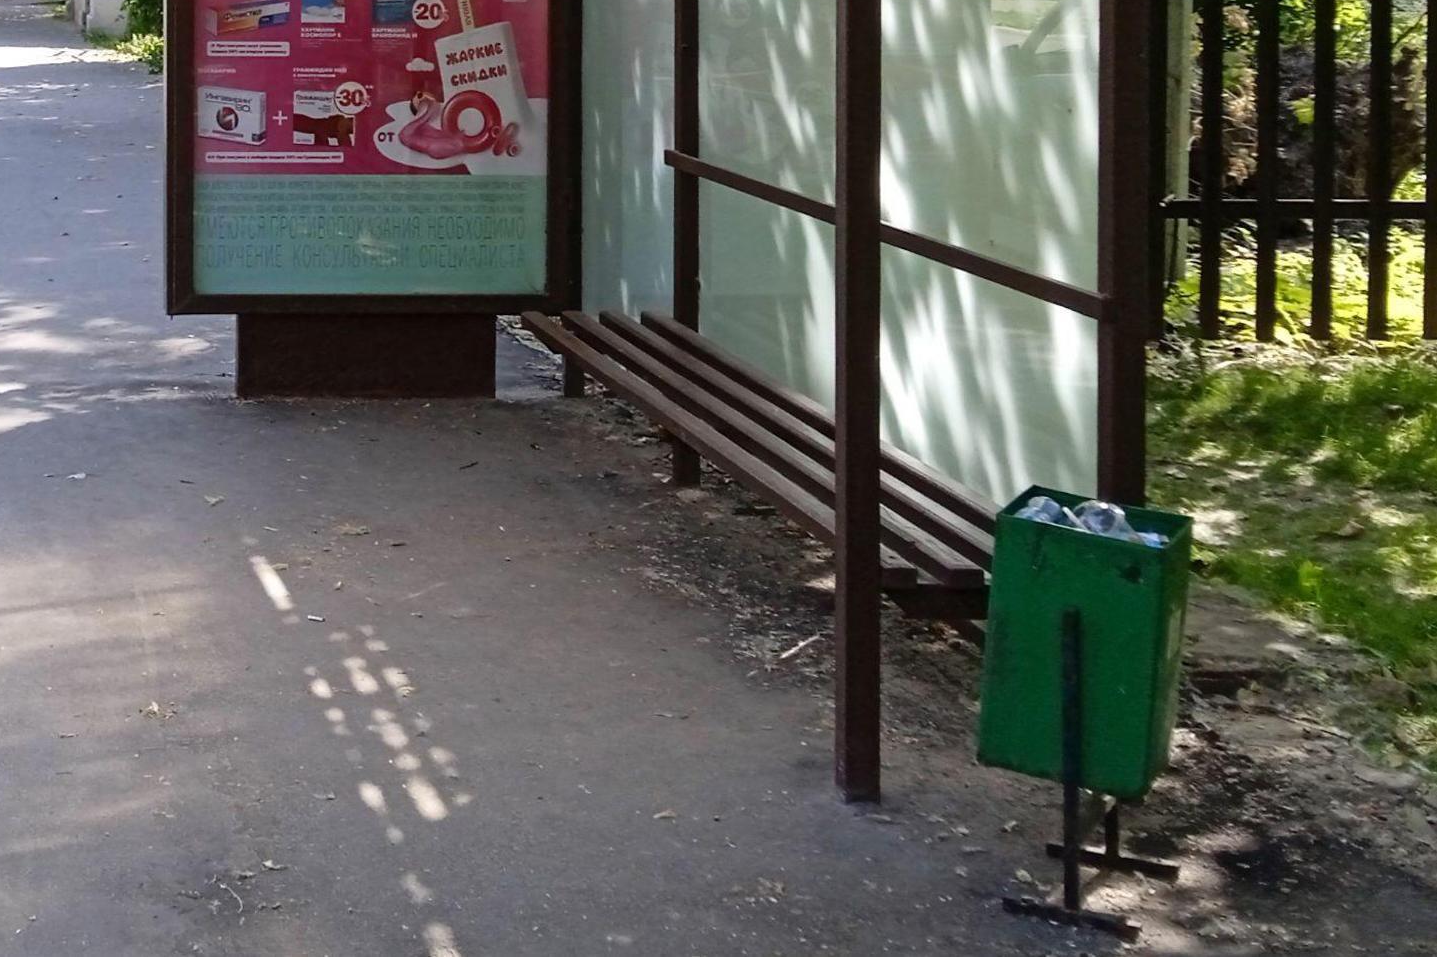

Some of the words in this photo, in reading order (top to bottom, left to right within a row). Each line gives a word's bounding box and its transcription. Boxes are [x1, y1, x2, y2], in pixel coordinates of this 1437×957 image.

[445, 42, 504, 66] ЖАРКИЕ
[450, 64, 508, 88] СКИДКИ
[377, 130, 396, 143] ОТ
